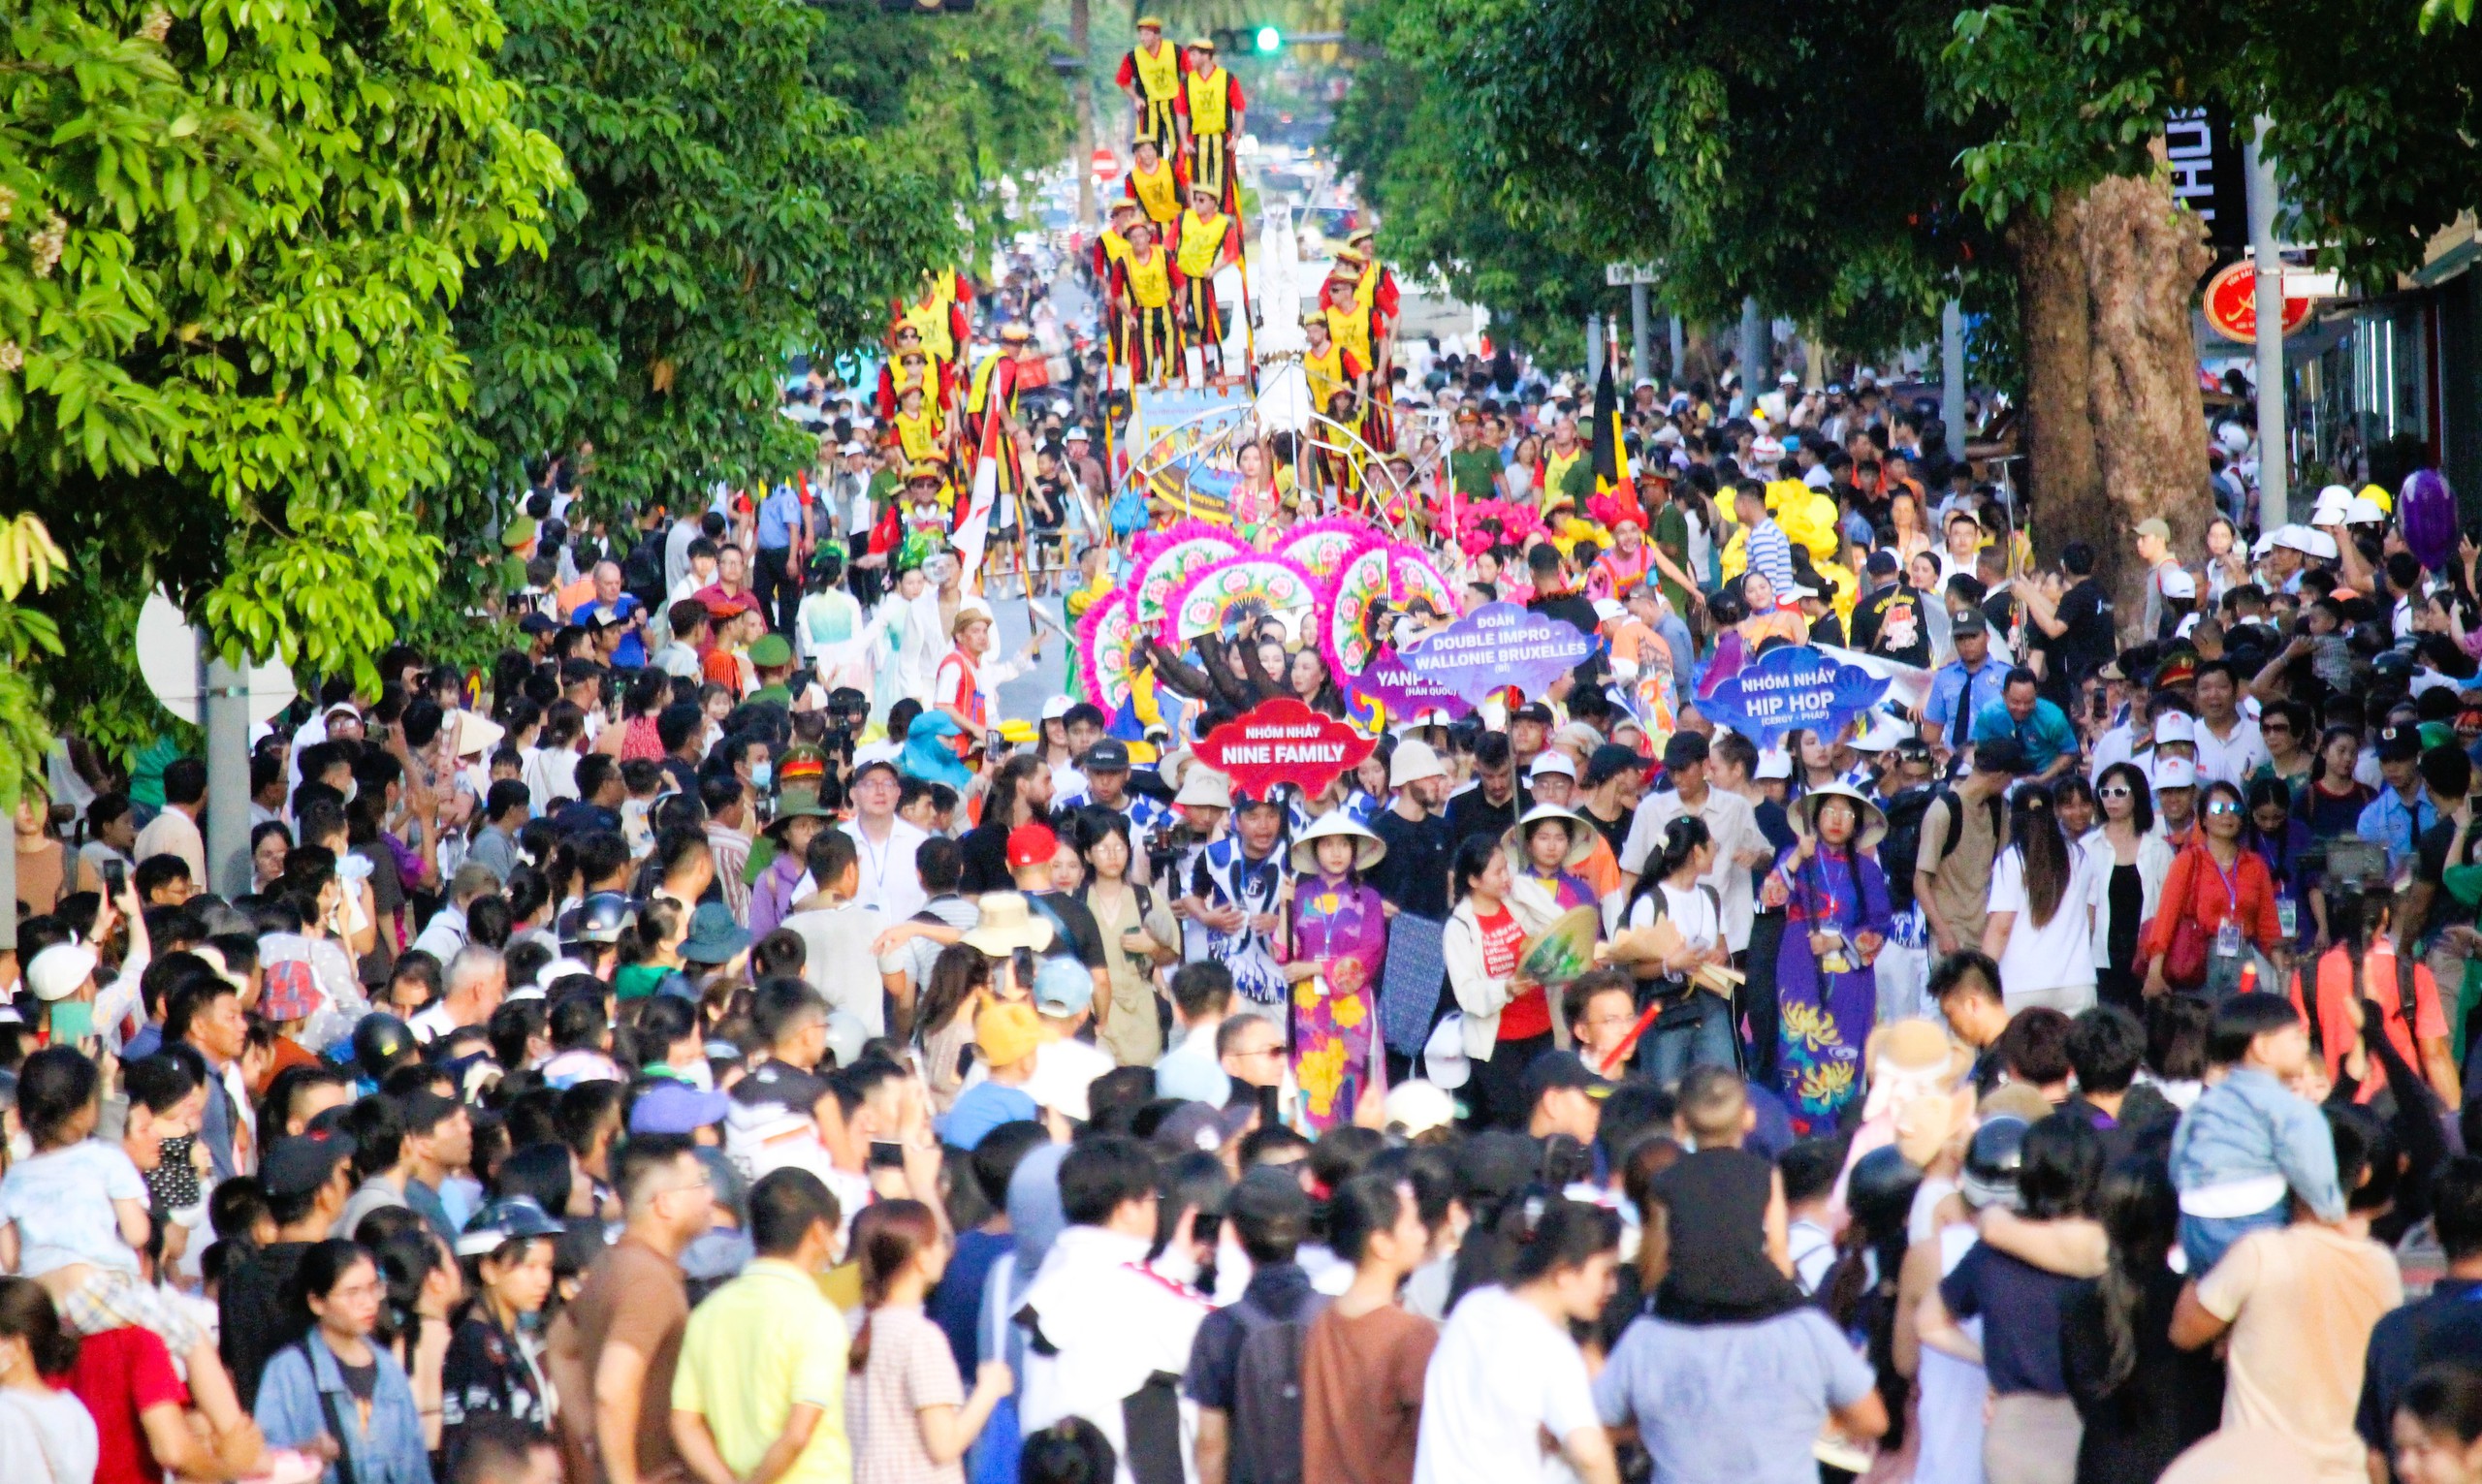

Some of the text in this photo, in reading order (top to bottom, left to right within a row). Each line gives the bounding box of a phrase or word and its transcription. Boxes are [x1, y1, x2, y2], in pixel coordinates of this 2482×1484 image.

[1477, 613, 1514, 629] ĐOÀN
[1433, 632, 1494, 651] DOUBLE
[1498, 628, 1550, 645] IMPRO
[1416, 642, 1587, 671] WALLONIE BRUXELLES
[1741, 674, 1791, 693] NHÓM
[1746, 690, 1835, 717] HIP HOP
[1245, 725, 1284, 740] NHÓM
[1222, 743, 1346, 765] NINE FAMILY
